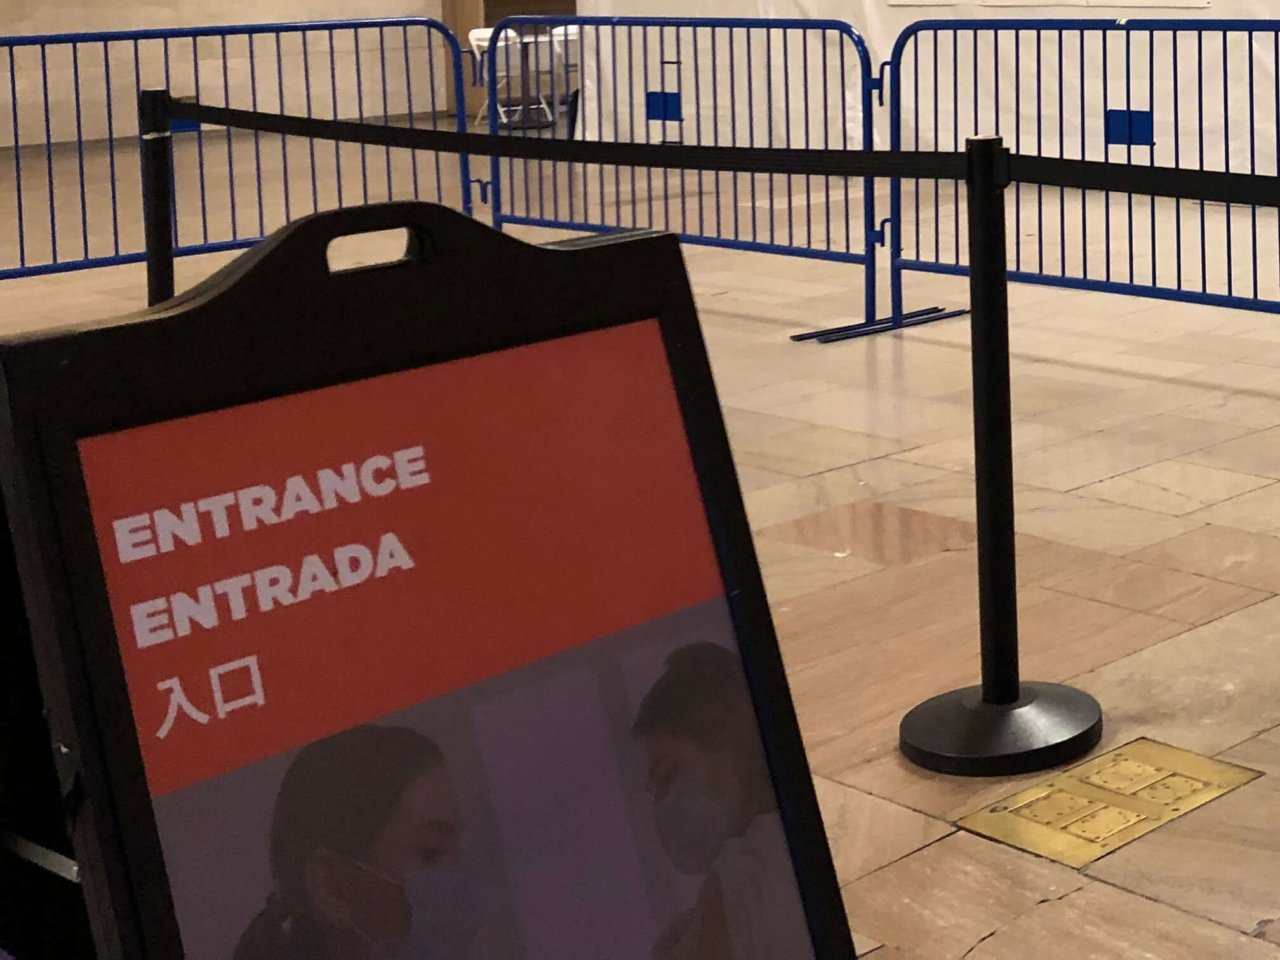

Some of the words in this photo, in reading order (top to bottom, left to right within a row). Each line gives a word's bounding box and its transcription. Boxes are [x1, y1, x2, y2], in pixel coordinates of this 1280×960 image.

[112, 445, 431, 563] ENTRANCE
[130, 531, 416, 649] ENTRADA
[155, 654, 265, 739] 入口
